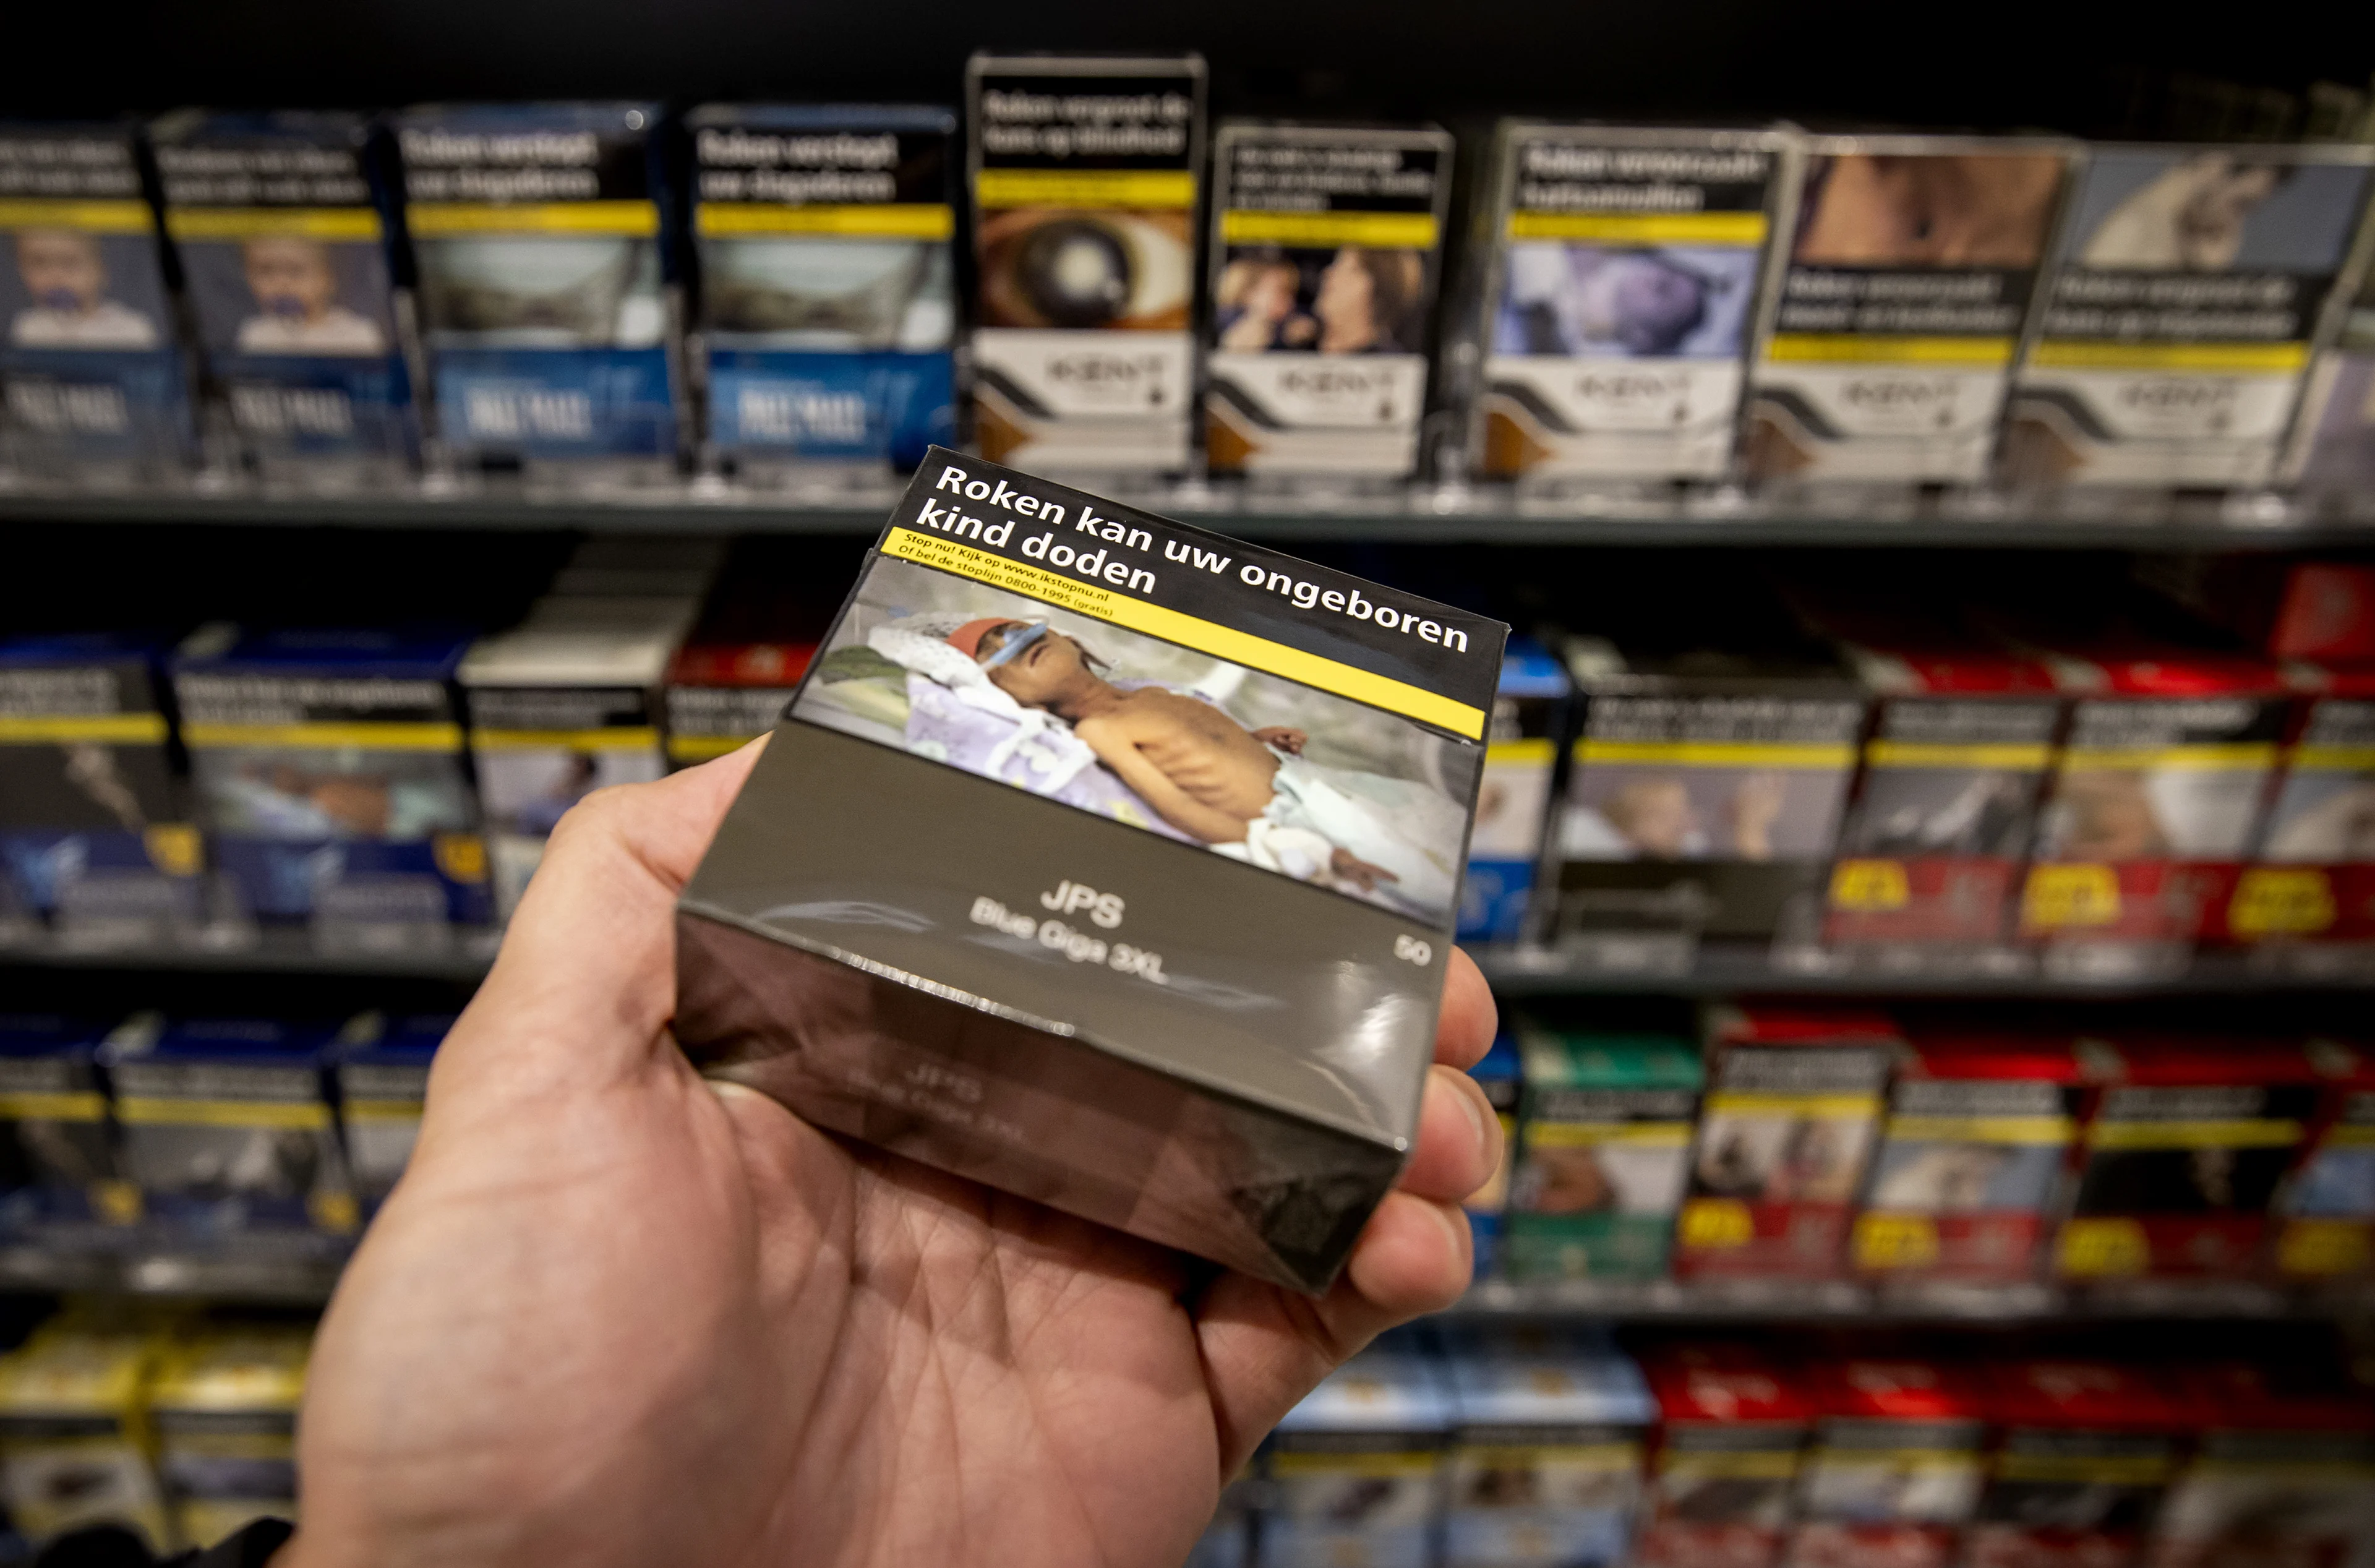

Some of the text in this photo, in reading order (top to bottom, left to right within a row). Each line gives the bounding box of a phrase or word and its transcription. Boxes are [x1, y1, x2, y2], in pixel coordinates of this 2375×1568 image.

[904, 533, 1110, 602] Stop nu! Kijk op www.ikstopnu.nl
[916, 497, 1155, 594] kind doden
[936, 466, 1468, 653] Roken kan uw ongeboren
[899, 545, 1114, 617] Of bel de stoplijn 0800-1995 (gratis)
[970, 896, 1037, 939] Blue
[1040, 880, 1125, 928] JPS
